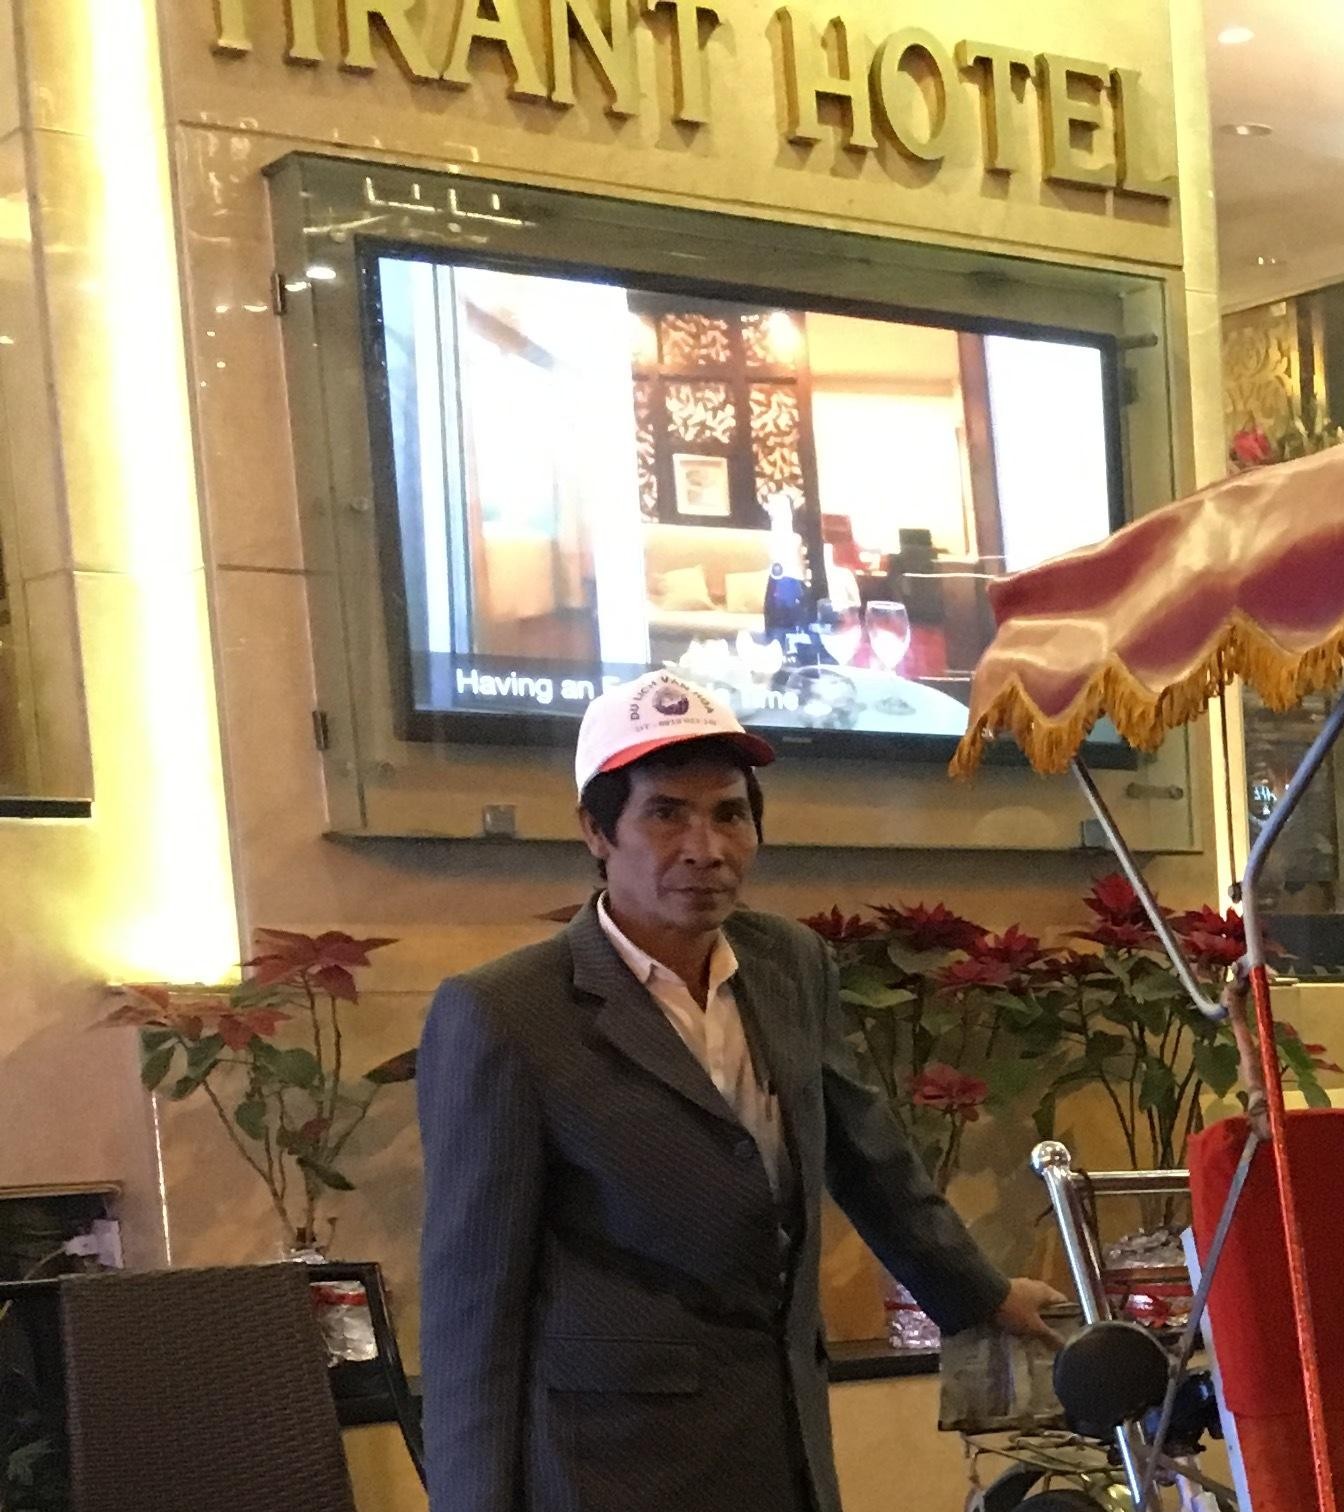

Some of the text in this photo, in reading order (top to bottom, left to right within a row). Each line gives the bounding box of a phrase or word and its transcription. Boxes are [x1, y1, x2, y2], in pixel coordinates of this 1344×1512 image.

[770, 5, 1180, 204] HOTEL
[456, 668, 553, 704] Having
[560, 679, 595, 700] an
